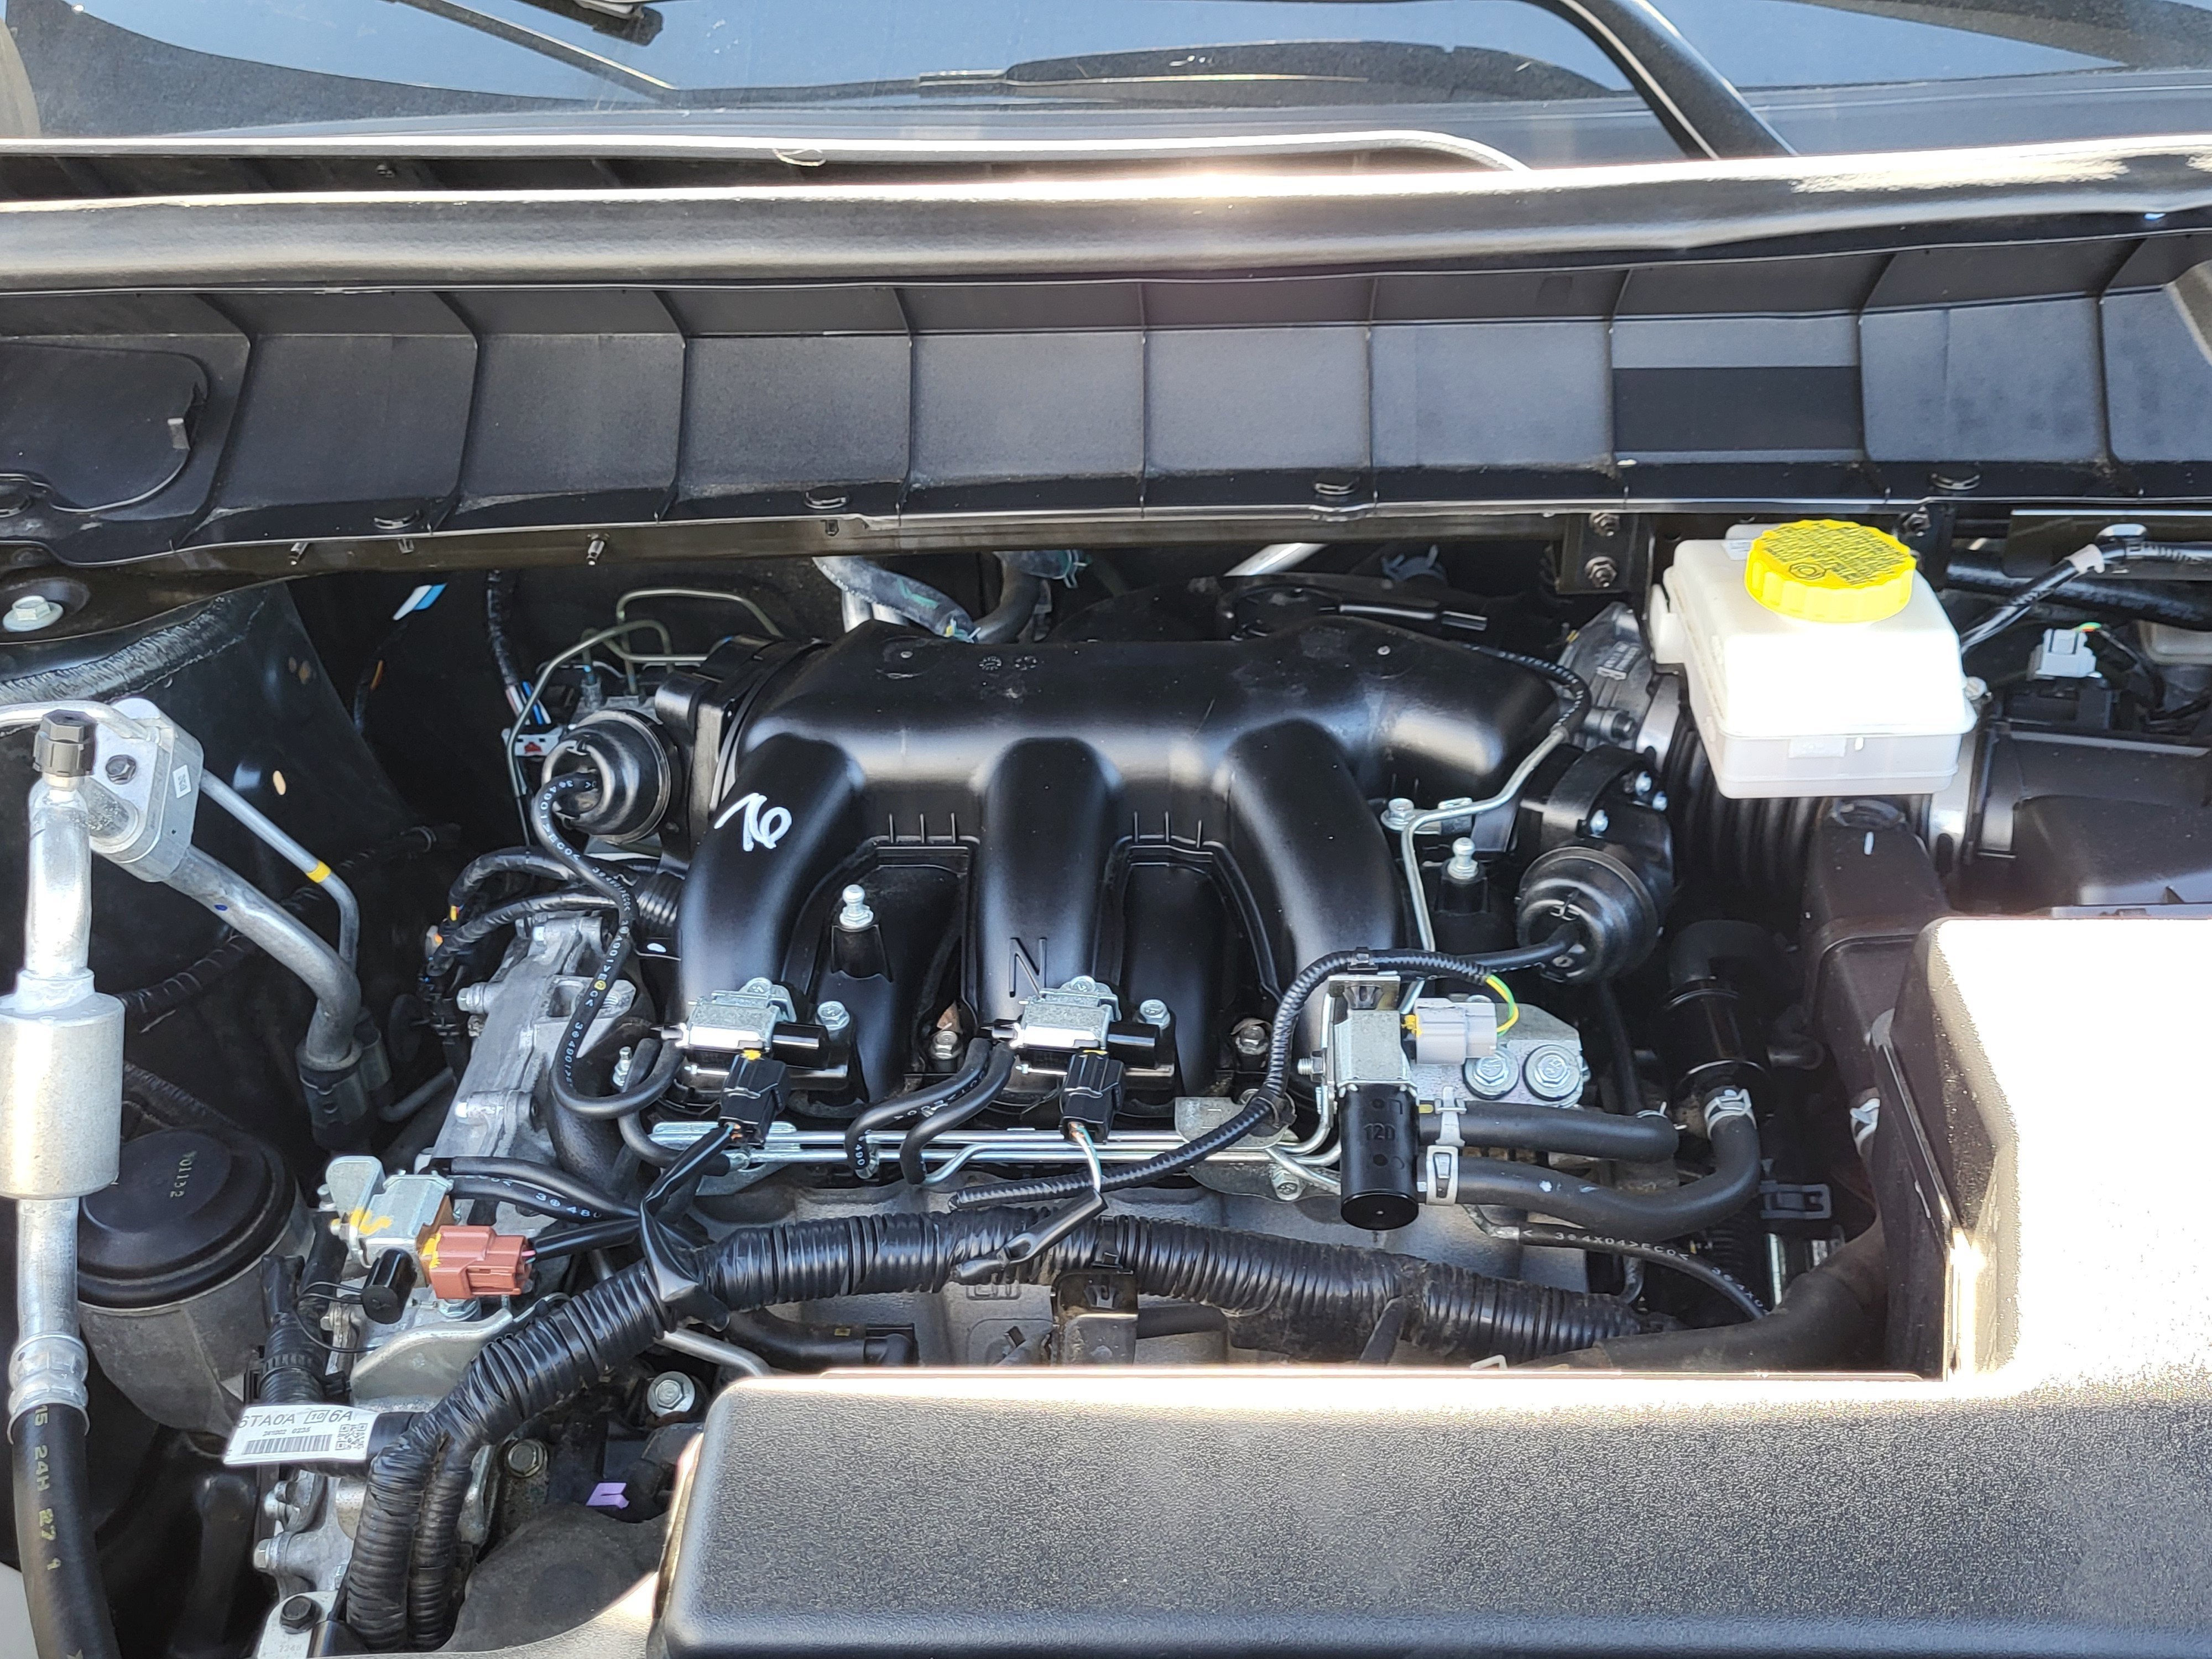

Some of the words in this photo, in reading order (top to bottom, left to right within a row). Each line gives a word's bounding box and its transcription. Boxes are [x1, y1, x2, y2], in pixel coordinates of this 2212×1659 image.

[714, 792, 792, 852] 16
[1009, 937, 1047, 999] N
[328, 1410, 353, 1423] 6A
[34, 1445, 50, 1491] 24H
